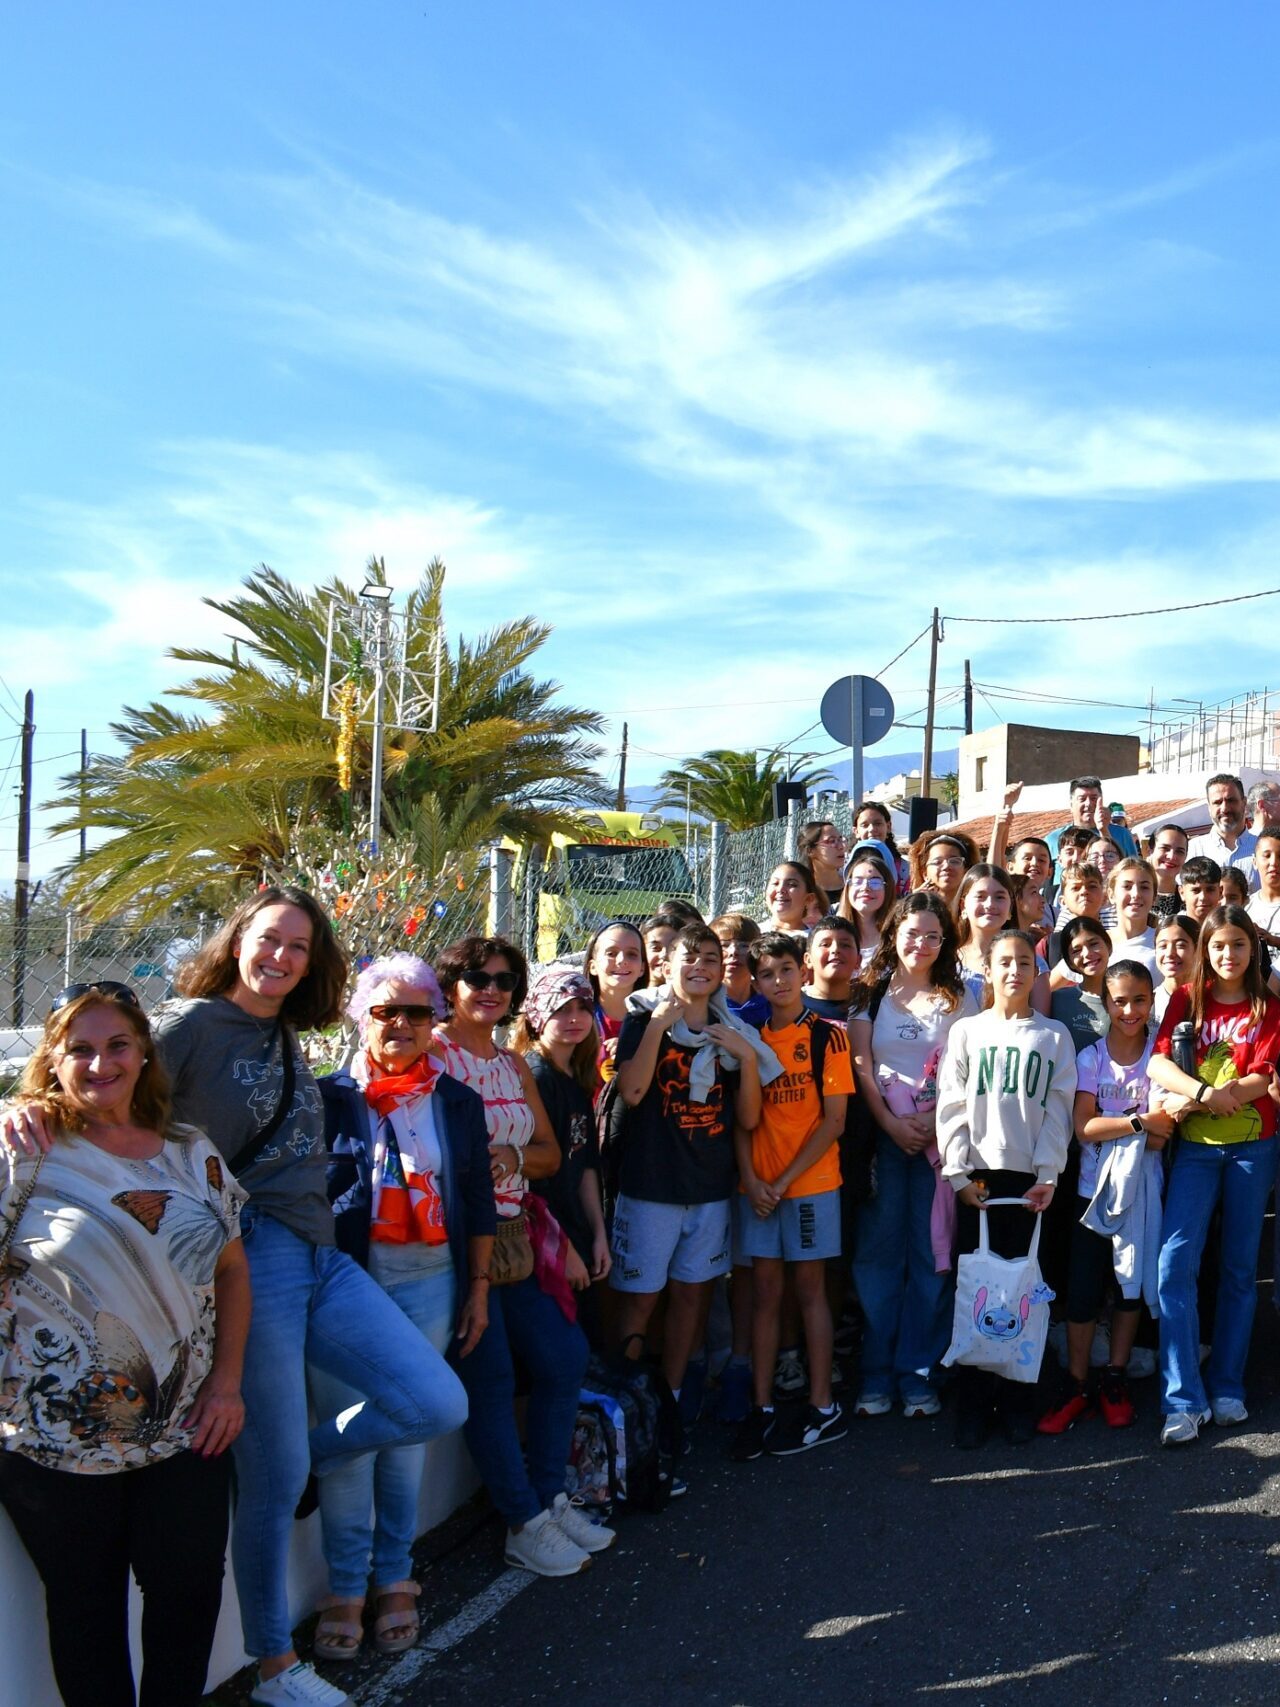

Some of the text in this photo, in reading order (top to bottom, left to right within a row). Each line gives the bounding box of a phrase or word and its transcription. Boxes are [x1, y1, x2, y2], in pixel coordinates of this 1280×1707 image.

[1197, 1015, 1263, 1050] RINCH
[771, 1070, 814, 1089] rates
[773, 1088, 806, 1104] BETTER
[1017, 1340, 1035, 1366] S
